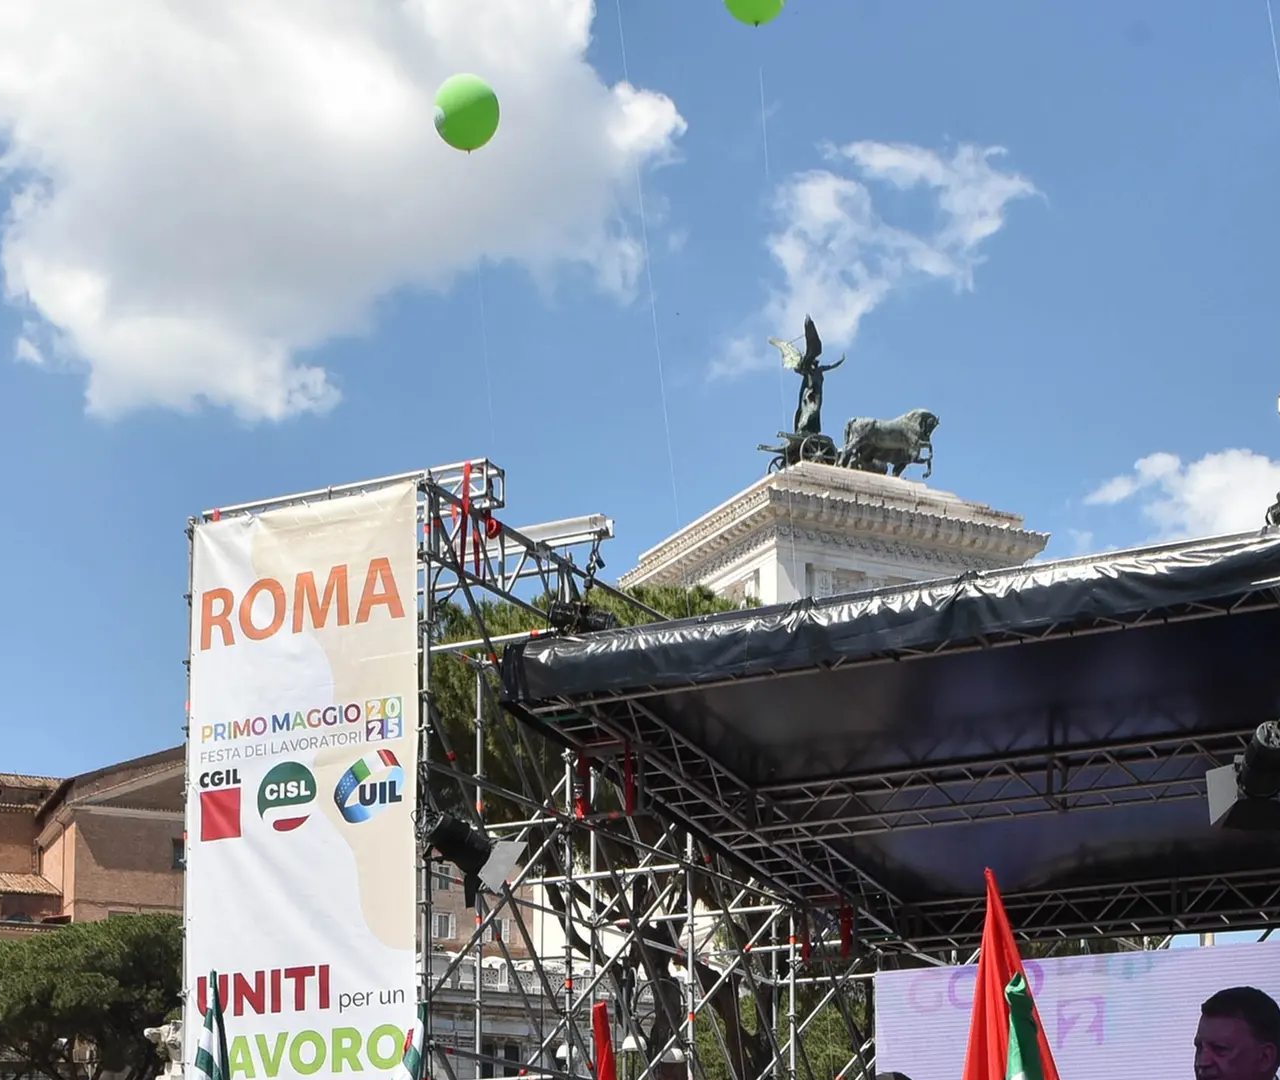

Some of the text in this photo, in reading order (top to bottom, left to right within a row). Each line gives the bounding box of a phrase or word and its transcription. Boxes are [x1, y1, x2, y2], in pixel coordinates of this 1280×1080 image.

[200, 556, 406, 651] ROMA
[201, 703, 362, 744] PRIMO MAGGIO
[200, 730, 362, 764] FESTA DEI LAVORATORI
[199, 768, 242, 788] CGIL
[265, 779, 311, 801] CISL
[359, 779, 403, 806] UIL
[197, 965, 405, 1017] UNITI per un
[226, 1024, 406, 1080] AVORO
